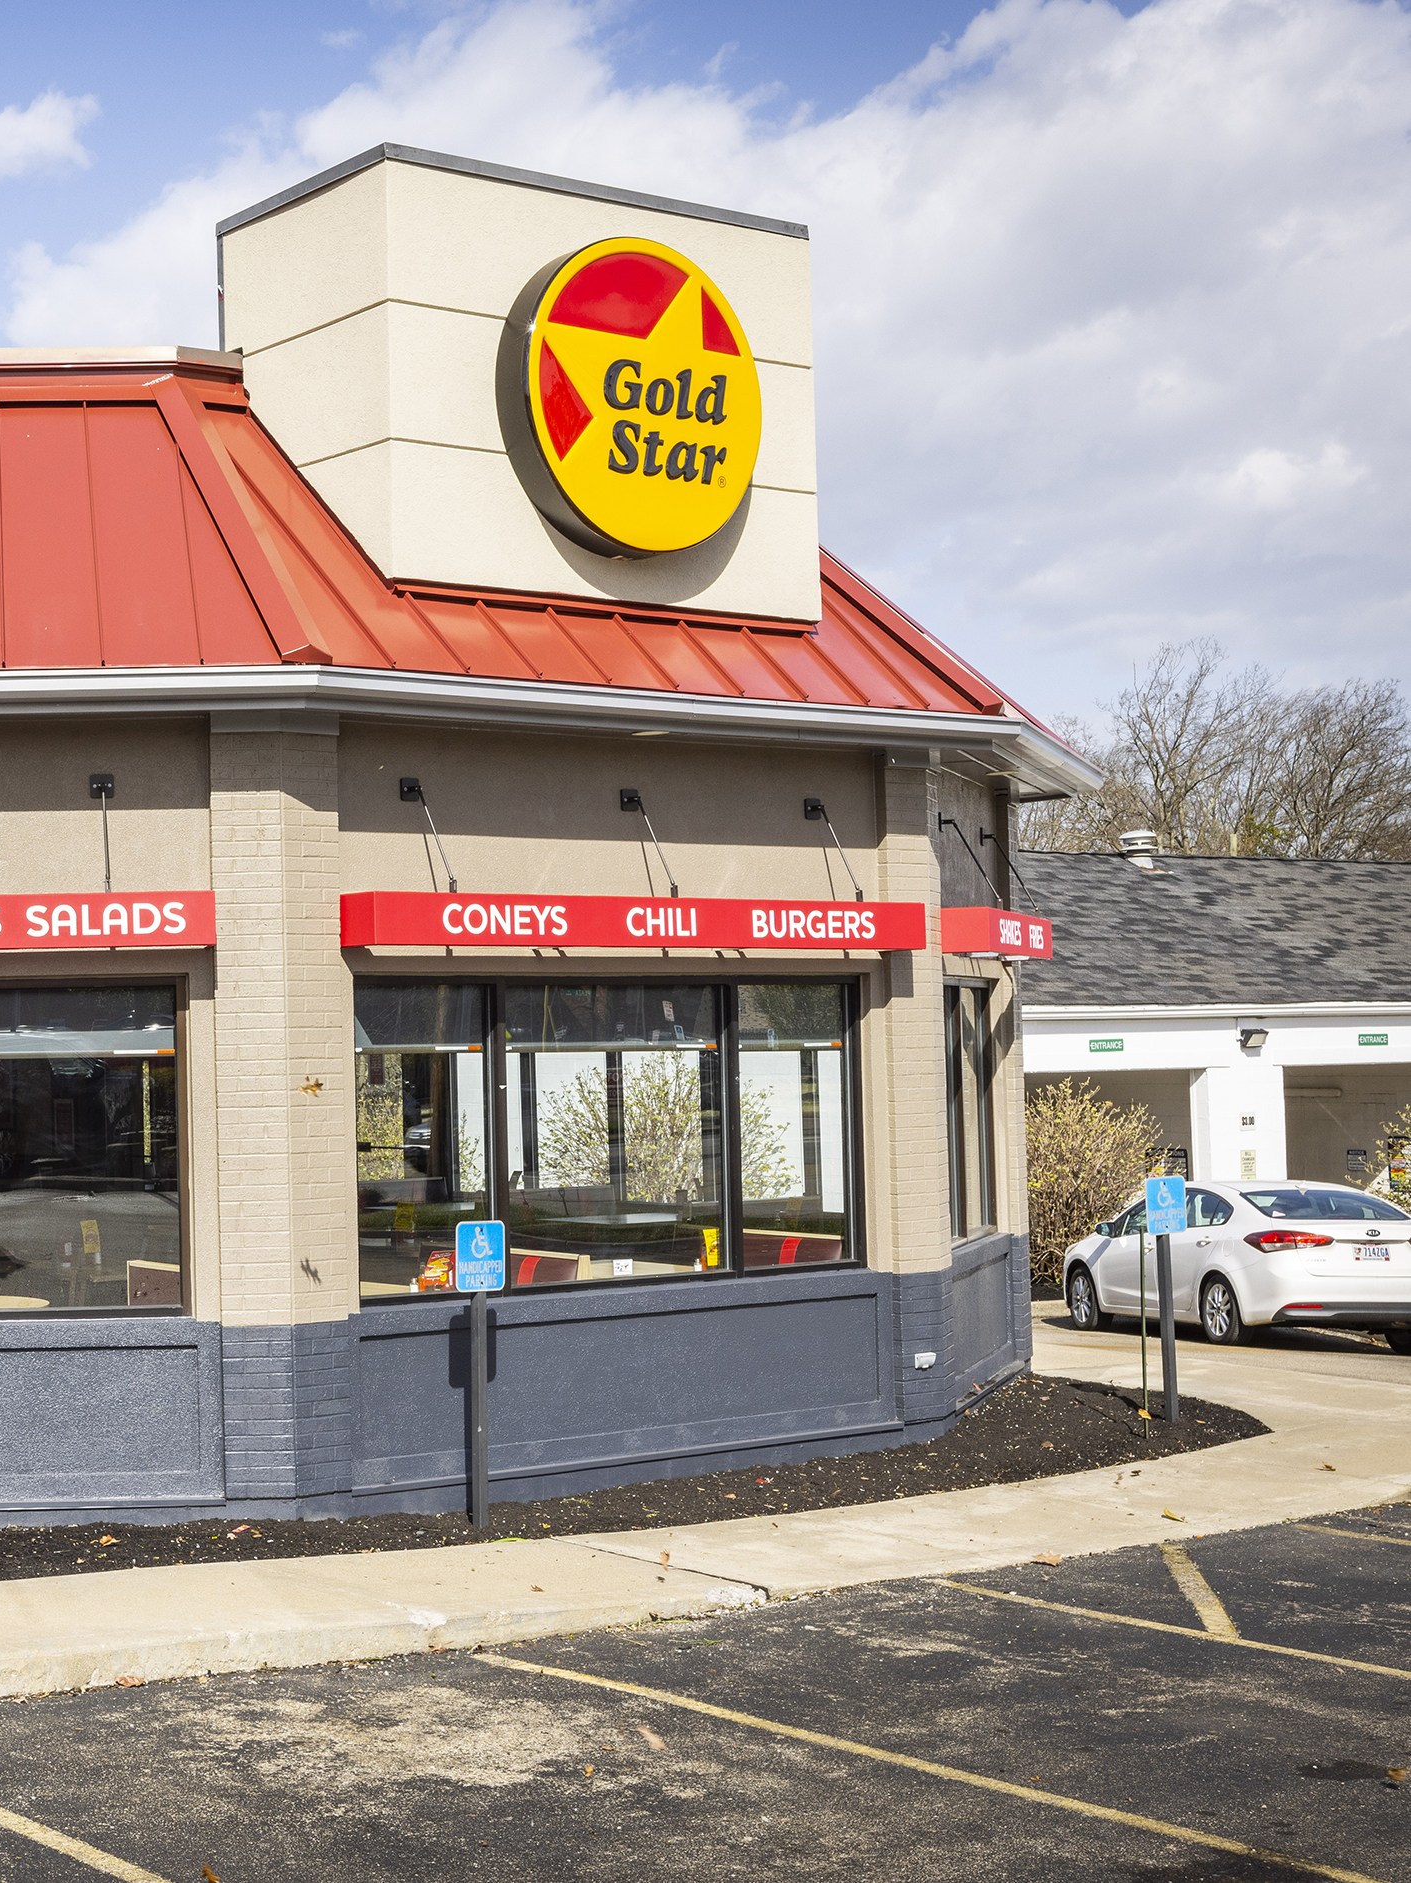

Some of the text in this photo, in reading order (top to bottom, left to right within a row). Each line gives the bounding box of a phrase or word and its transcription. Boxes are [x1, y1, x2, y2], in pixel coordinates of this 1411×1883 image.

[603, 358, 728, 426] Gold
[608, 419, 727, 486] Star
[25, 901, 187, 938] SALADS
[442, 902, 876, 940] CONEYS CHILI BURGERS
[999, 917, 1044, 950] SHAKES FRIES
[1090, 1041, 1123, 1050] ENTRANCE
[1359, 1035, 1387, 1044] ENTRANCE
[1148, 1207, 1185, 1221] HANDICAPPED
[1154, 1219, 1181, 1232] PARKING
[1363, 1247, 1390, 1257] 714ZGA
[458, 1260, 503, 1275] HANDICAPPED
[465, 1274, 498, 1288] PARKING
